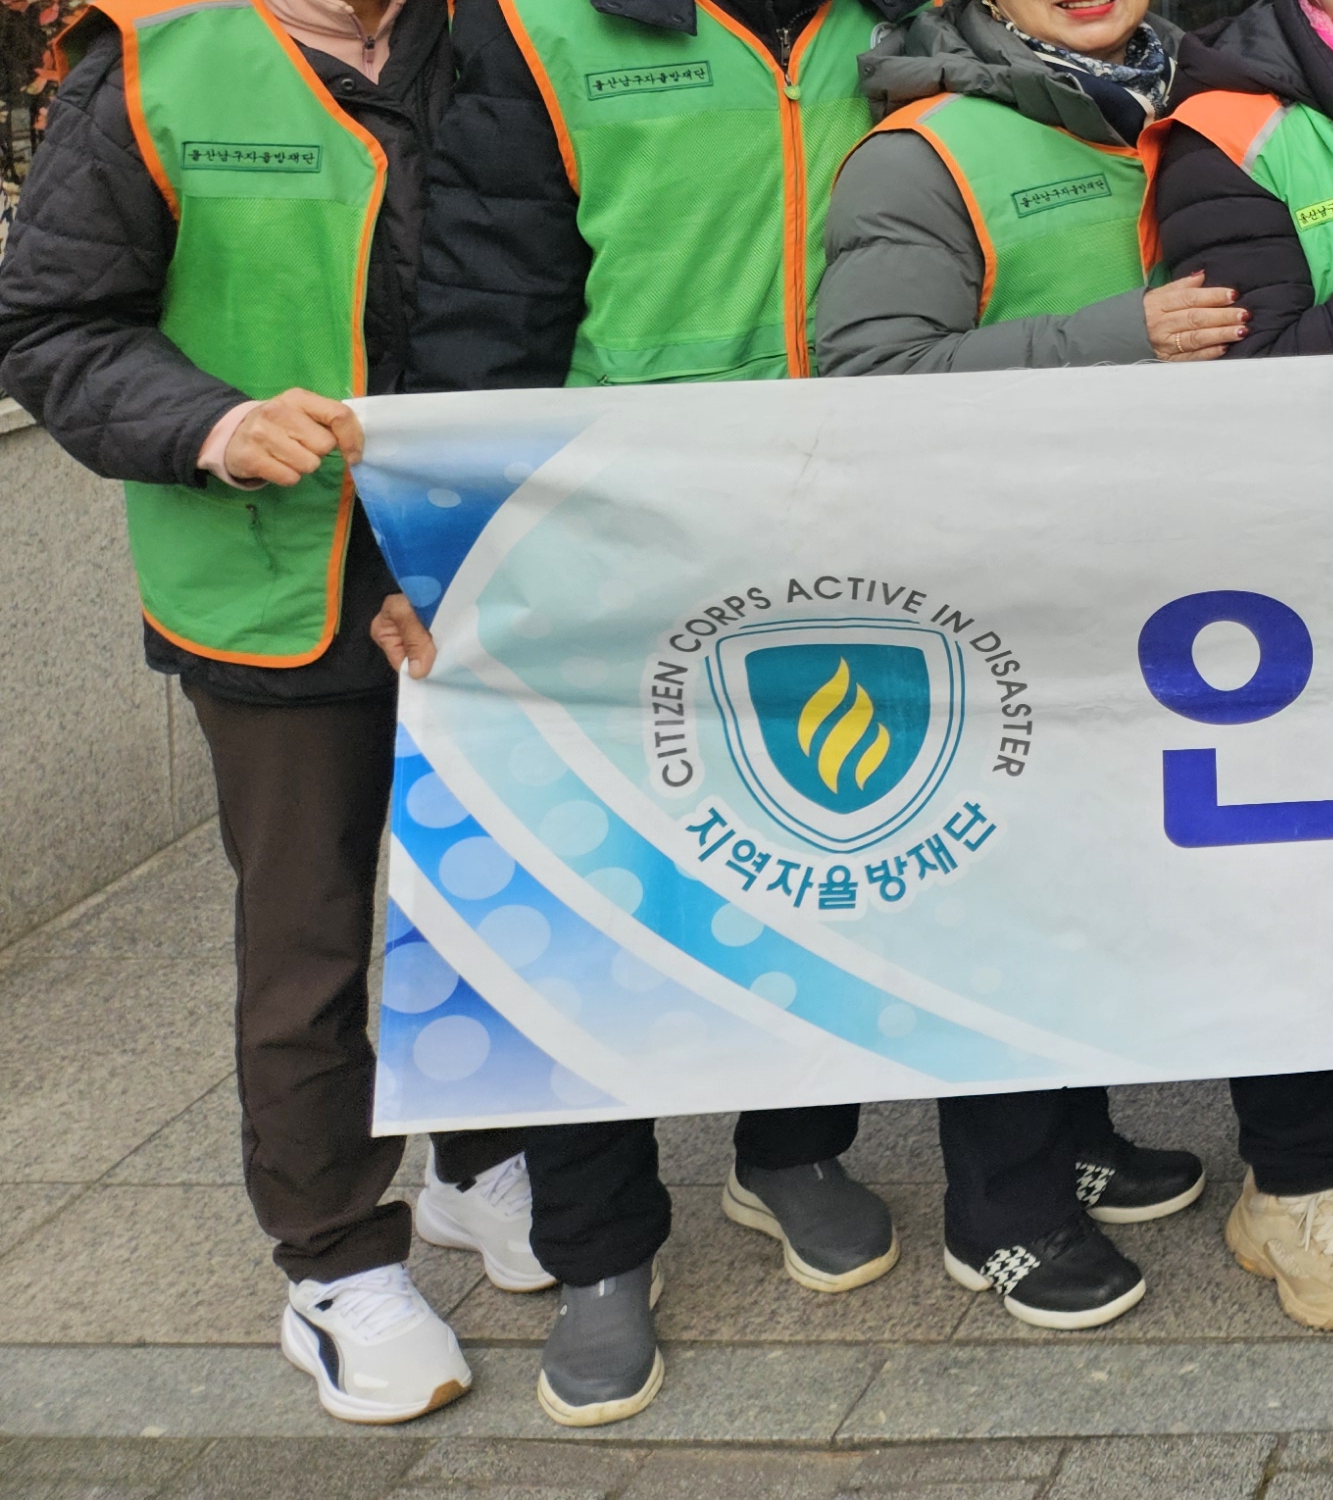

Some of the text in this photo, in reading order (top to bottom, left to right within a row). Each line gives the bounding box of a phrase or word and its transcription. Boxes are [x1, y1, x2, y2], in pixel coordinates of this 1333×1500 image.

[188, 148, 315, 166] 울산남구자율방재단
[652, 575, 1033, 787] CITIZEN CORPS ACTIVE IN DISASTER
[685, 801, 997, 910] 지역자율방재단
